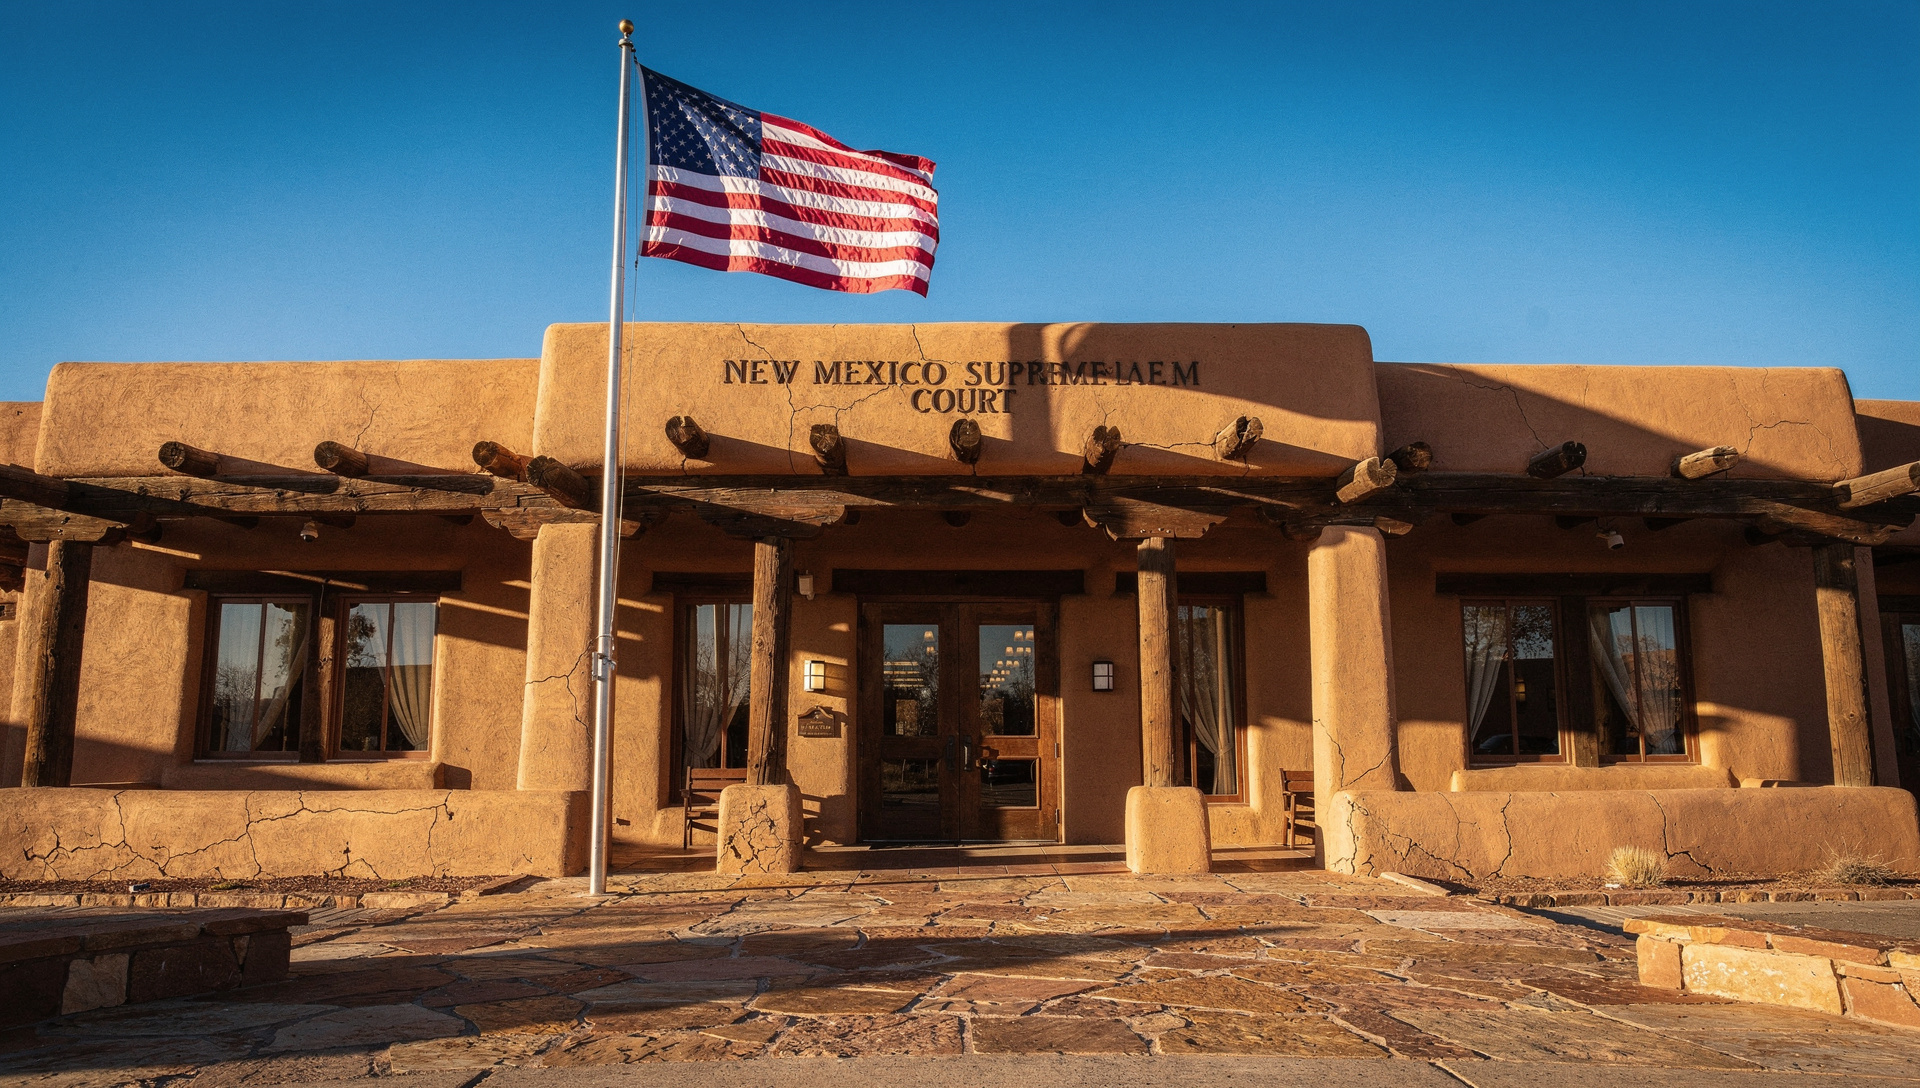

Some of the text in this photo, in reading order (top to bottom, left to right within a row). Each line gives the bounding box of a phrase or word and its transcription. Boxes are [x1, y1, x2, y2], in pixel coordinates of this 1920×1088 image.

[723, 359, 800, 385] NEW
[813, 360, 947, 386] MEXICO
[910, 388, 1017, 414] COURT
